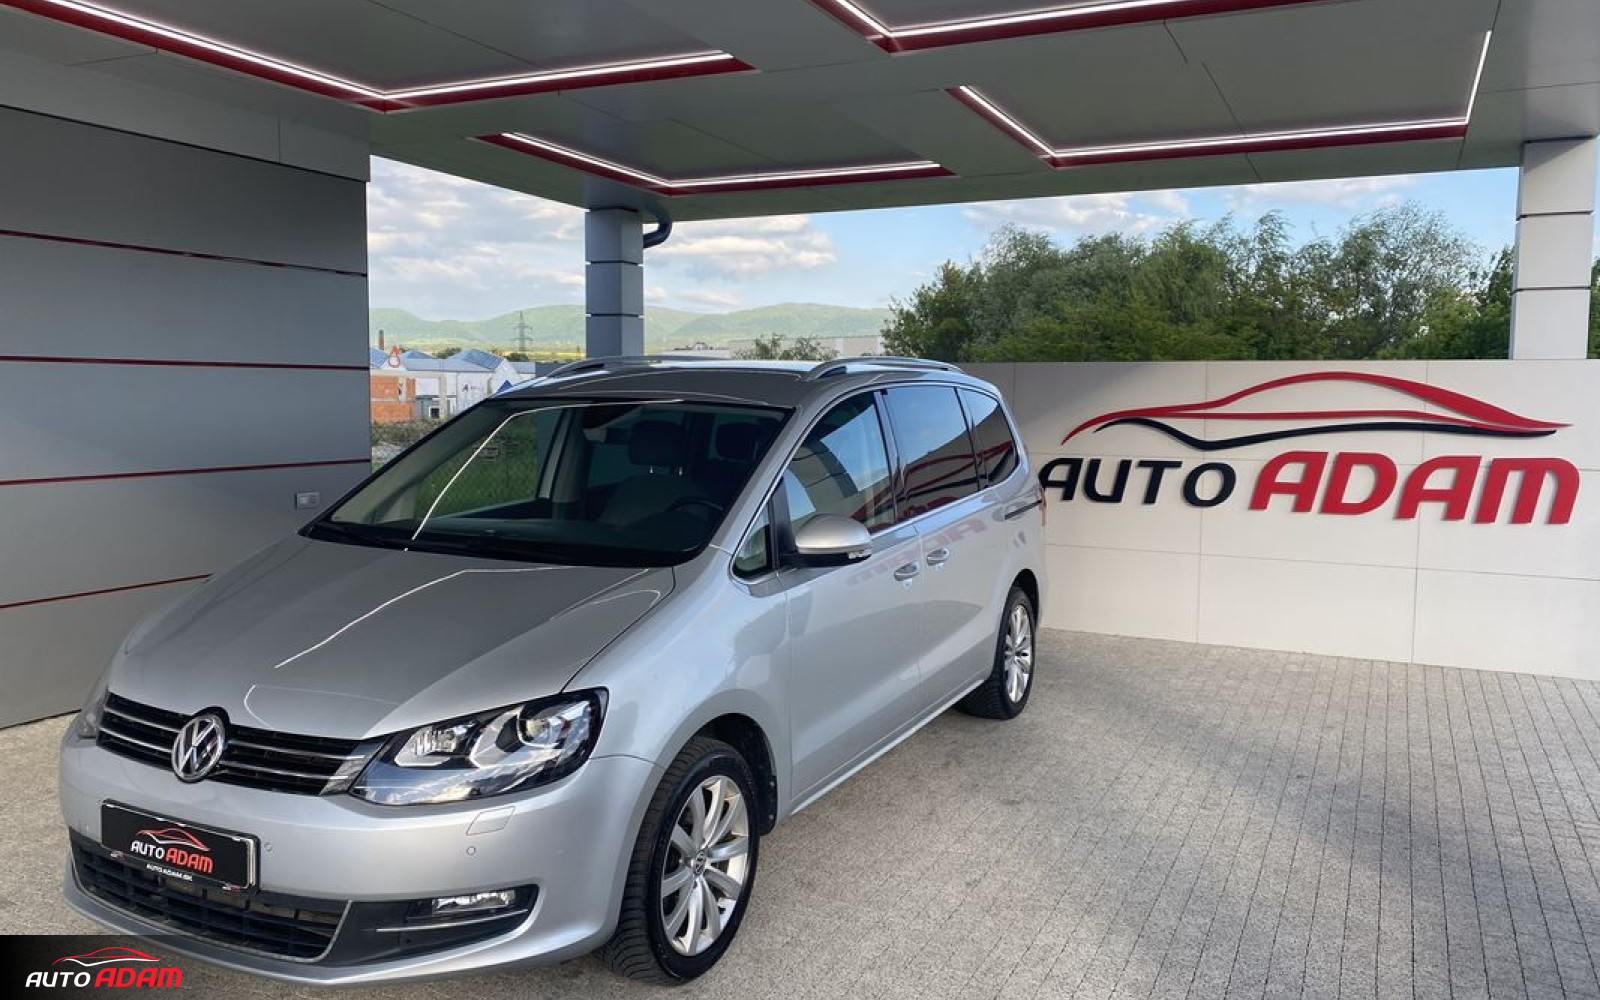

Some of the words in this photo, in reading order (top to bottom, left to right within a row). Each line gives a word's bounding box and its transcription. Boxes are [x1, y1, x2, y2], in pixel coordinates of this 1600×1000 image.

[1038, 457, 1236, 507] AUTO
[1250, 451, 1580, 525] ADAM
[131, 840, 165, 859] AUTO
[166, 847, 213, 873] ADAM
